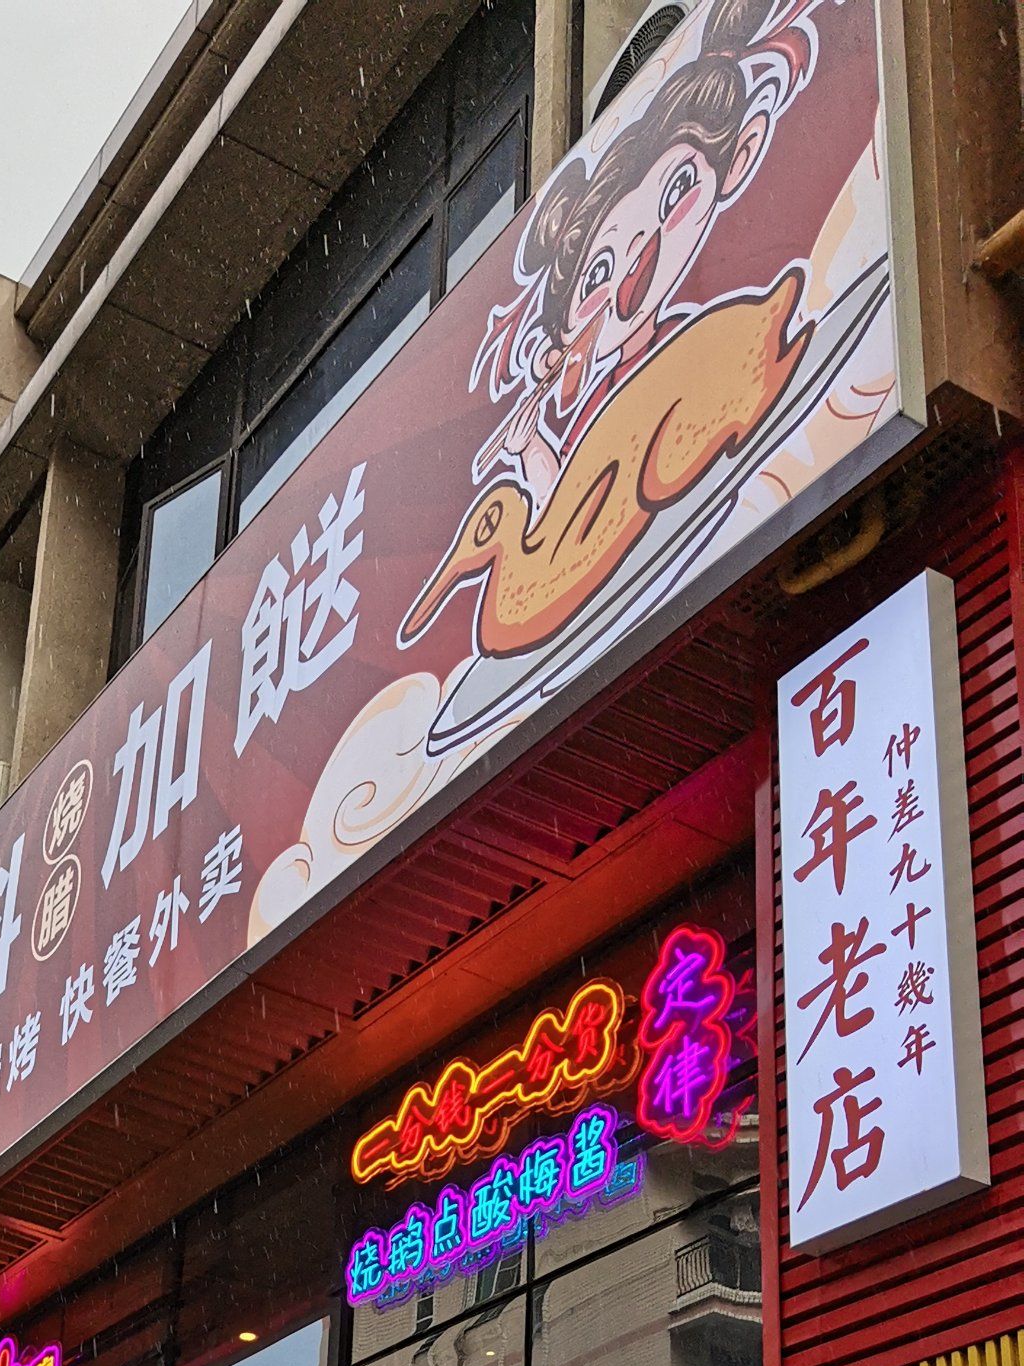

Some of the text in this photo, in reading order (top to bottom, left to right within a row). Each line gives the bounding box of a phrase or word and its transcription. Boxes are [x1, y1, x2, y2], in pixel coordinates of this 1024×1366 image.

[37, 772, 87, 949] 烧腊
[59, 824, 245, 1046] 快餐外卖
[791, 638, 887, 1213] 百年老店
[882, 723, 937, 1076] 仲差九十幾年
[363, 1002, 606, 1160] 一分钱一分货
[654, 948, 716, 1118] 定律
[350, 1116, 608, 1296] 烧鹅点酸梅酱
